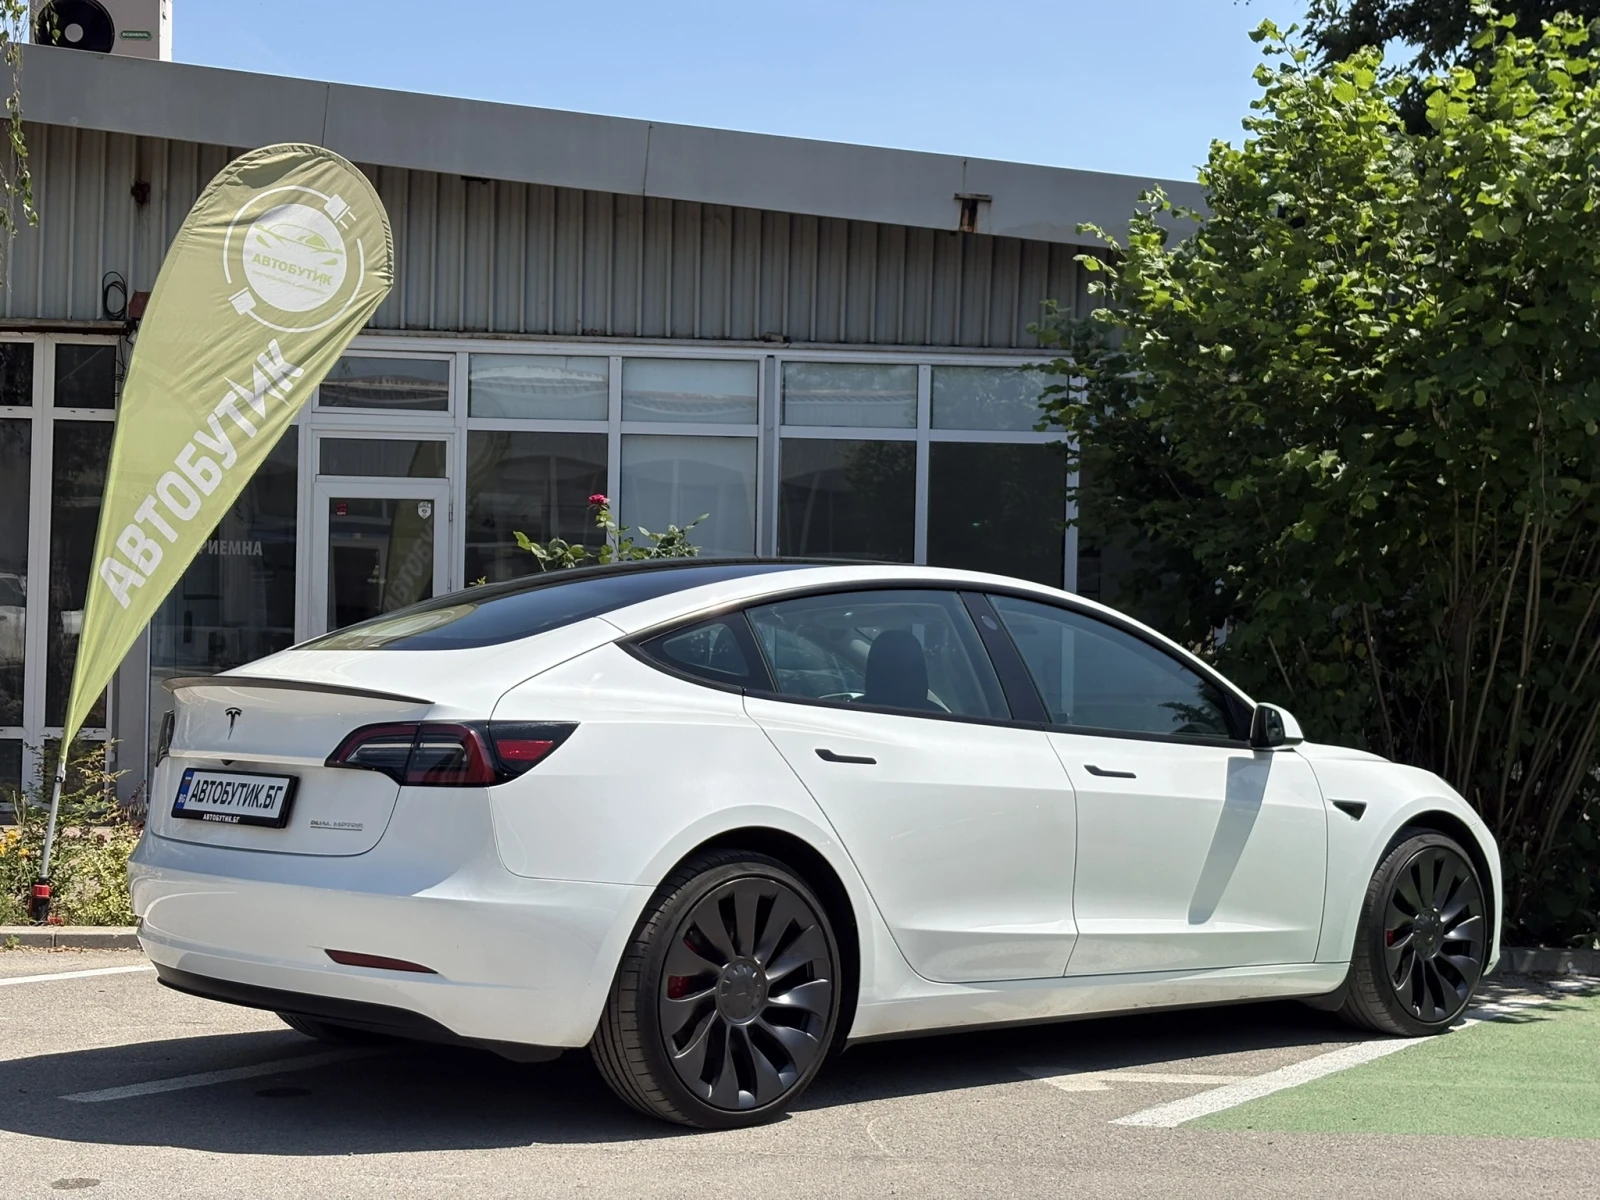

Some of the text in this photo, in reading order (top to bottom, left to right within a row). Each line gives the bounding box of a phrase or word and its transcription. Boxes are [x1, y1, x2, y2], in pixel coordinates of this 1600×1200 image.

[252, 253, 333, 286] АВТОБУТИК
[100, 339, 304, 609] АВТОБУТИК
[189, 779, 284, 809] АВТОБУТИК.БГ
[202, 813, 240, 823] АВТОБУТИК.БГ
